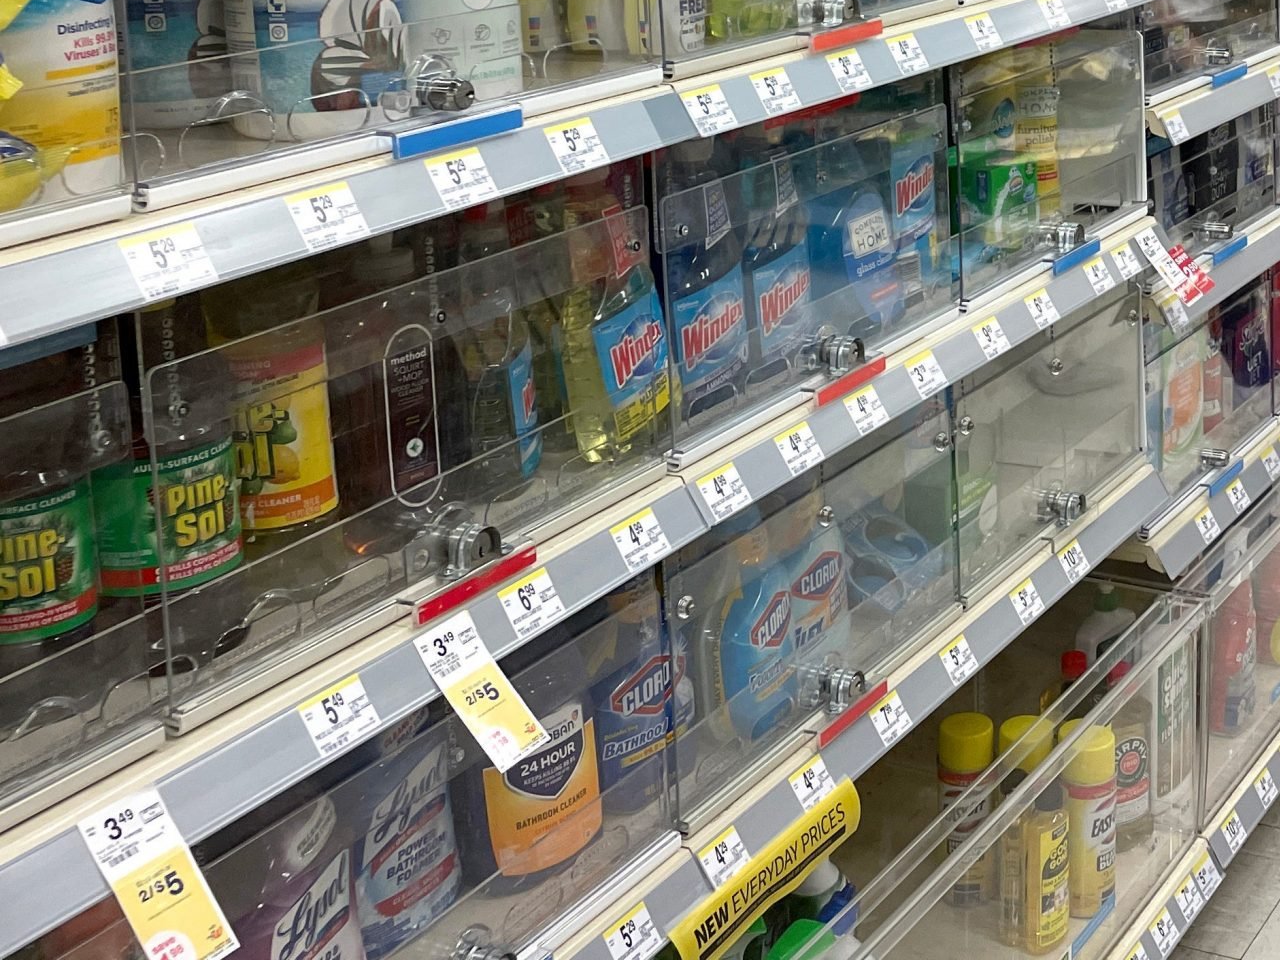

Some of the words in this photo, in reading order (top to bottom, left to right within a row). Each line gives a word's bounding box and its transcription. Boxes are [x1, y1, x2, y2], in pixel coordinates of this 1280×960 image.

[57, 19, 111, 36] Disinfecting
[64, 46, 101, 62] Viruses
[73, 36, 95, 49] Kills
[857, 229, 888, 252] HOME
[856, 260, 876, 278] glass
[682, 299, 744, 371] Windex
[390, 347, 428, 366] method
[610, 318, 664, 389] Windex
[393, 360, 425, 376] SQUIRT
[39, 489, 77, 508] CLEANER
[258, 493, 302, 509] CLEANER
[175, 501, 225, 548] Sol
[169, 560, 192, 574] KILLS
[170, 569, 194, 582] KILLS
[800, 557, 840, 596] CLOROX
[622, 661, 671, 718] CLORO
[520, 759, 538, 778] 24
[541, 742, 576, 771] HOUR
[515, 805, 560, 832] BATHROOM
[561, 788, 587, 811] CLEANER
[386, 831, 446, 880] BATHROOM
[397, 828, 436, 862] POWER
[396, 849, 441, 886] FOAMER
[693, 902, 730, 950] NEW
[731, 847, 799, 914] EVERYDAY
[801, 802, 846, 855] PRICES
